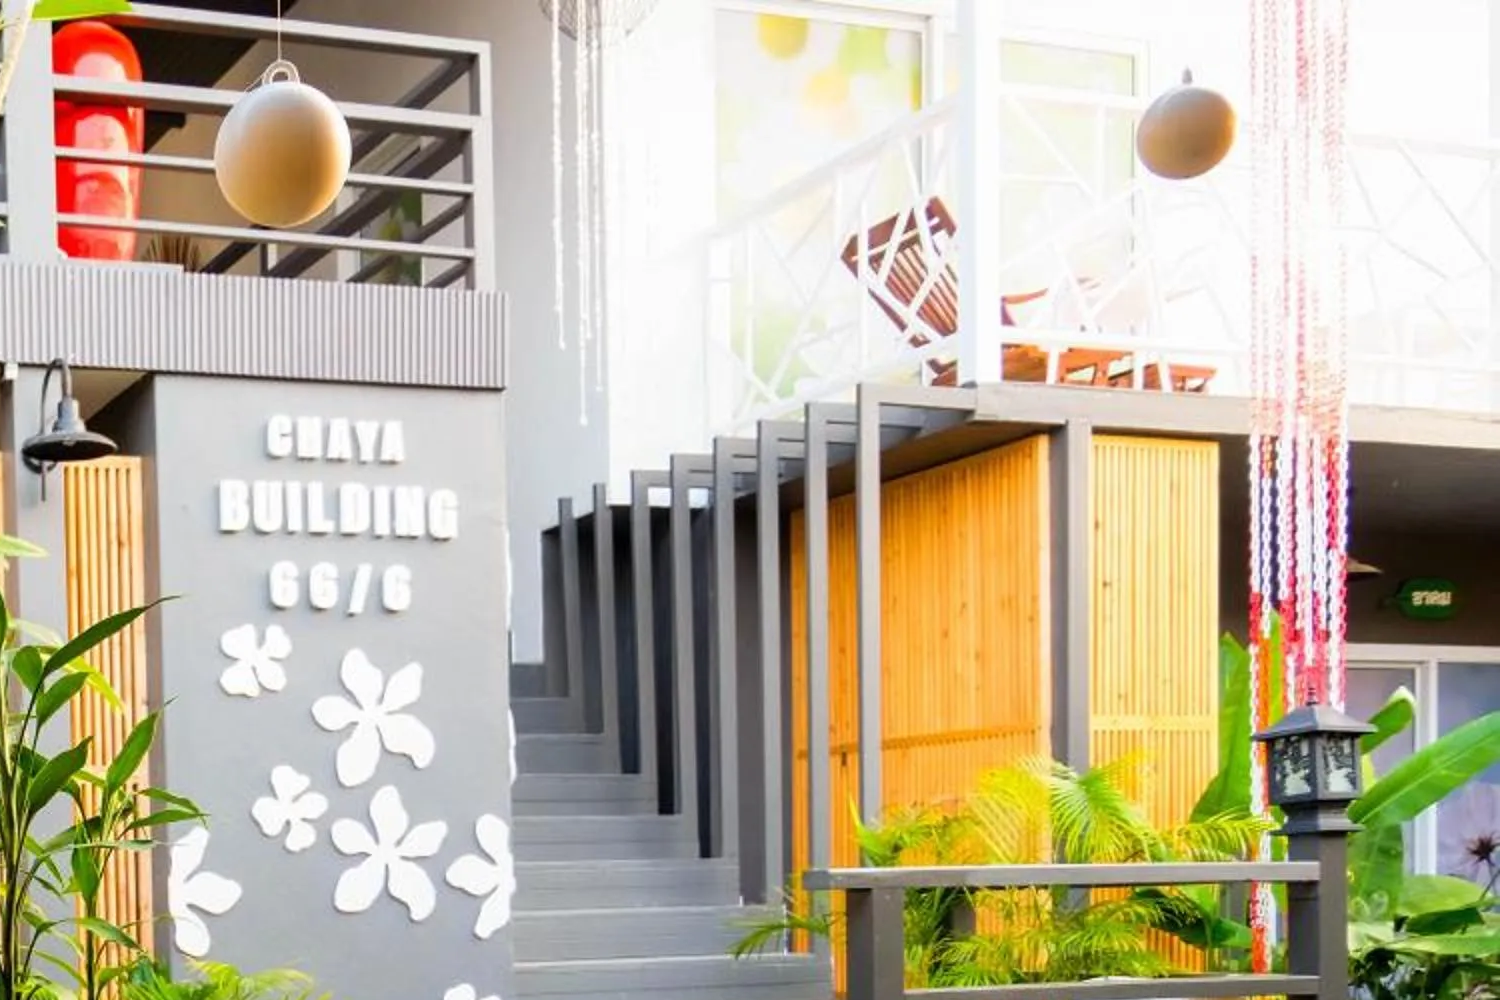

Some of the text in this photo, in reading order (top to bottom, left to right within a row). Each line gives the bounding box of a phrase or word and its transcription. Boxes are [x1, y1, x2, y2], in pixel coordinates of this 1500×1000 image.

[267, 414, 404, 462] CHAYA
[218, 478, 458, 539] BUILDING
[269, 560, 411, 616] 66/6
